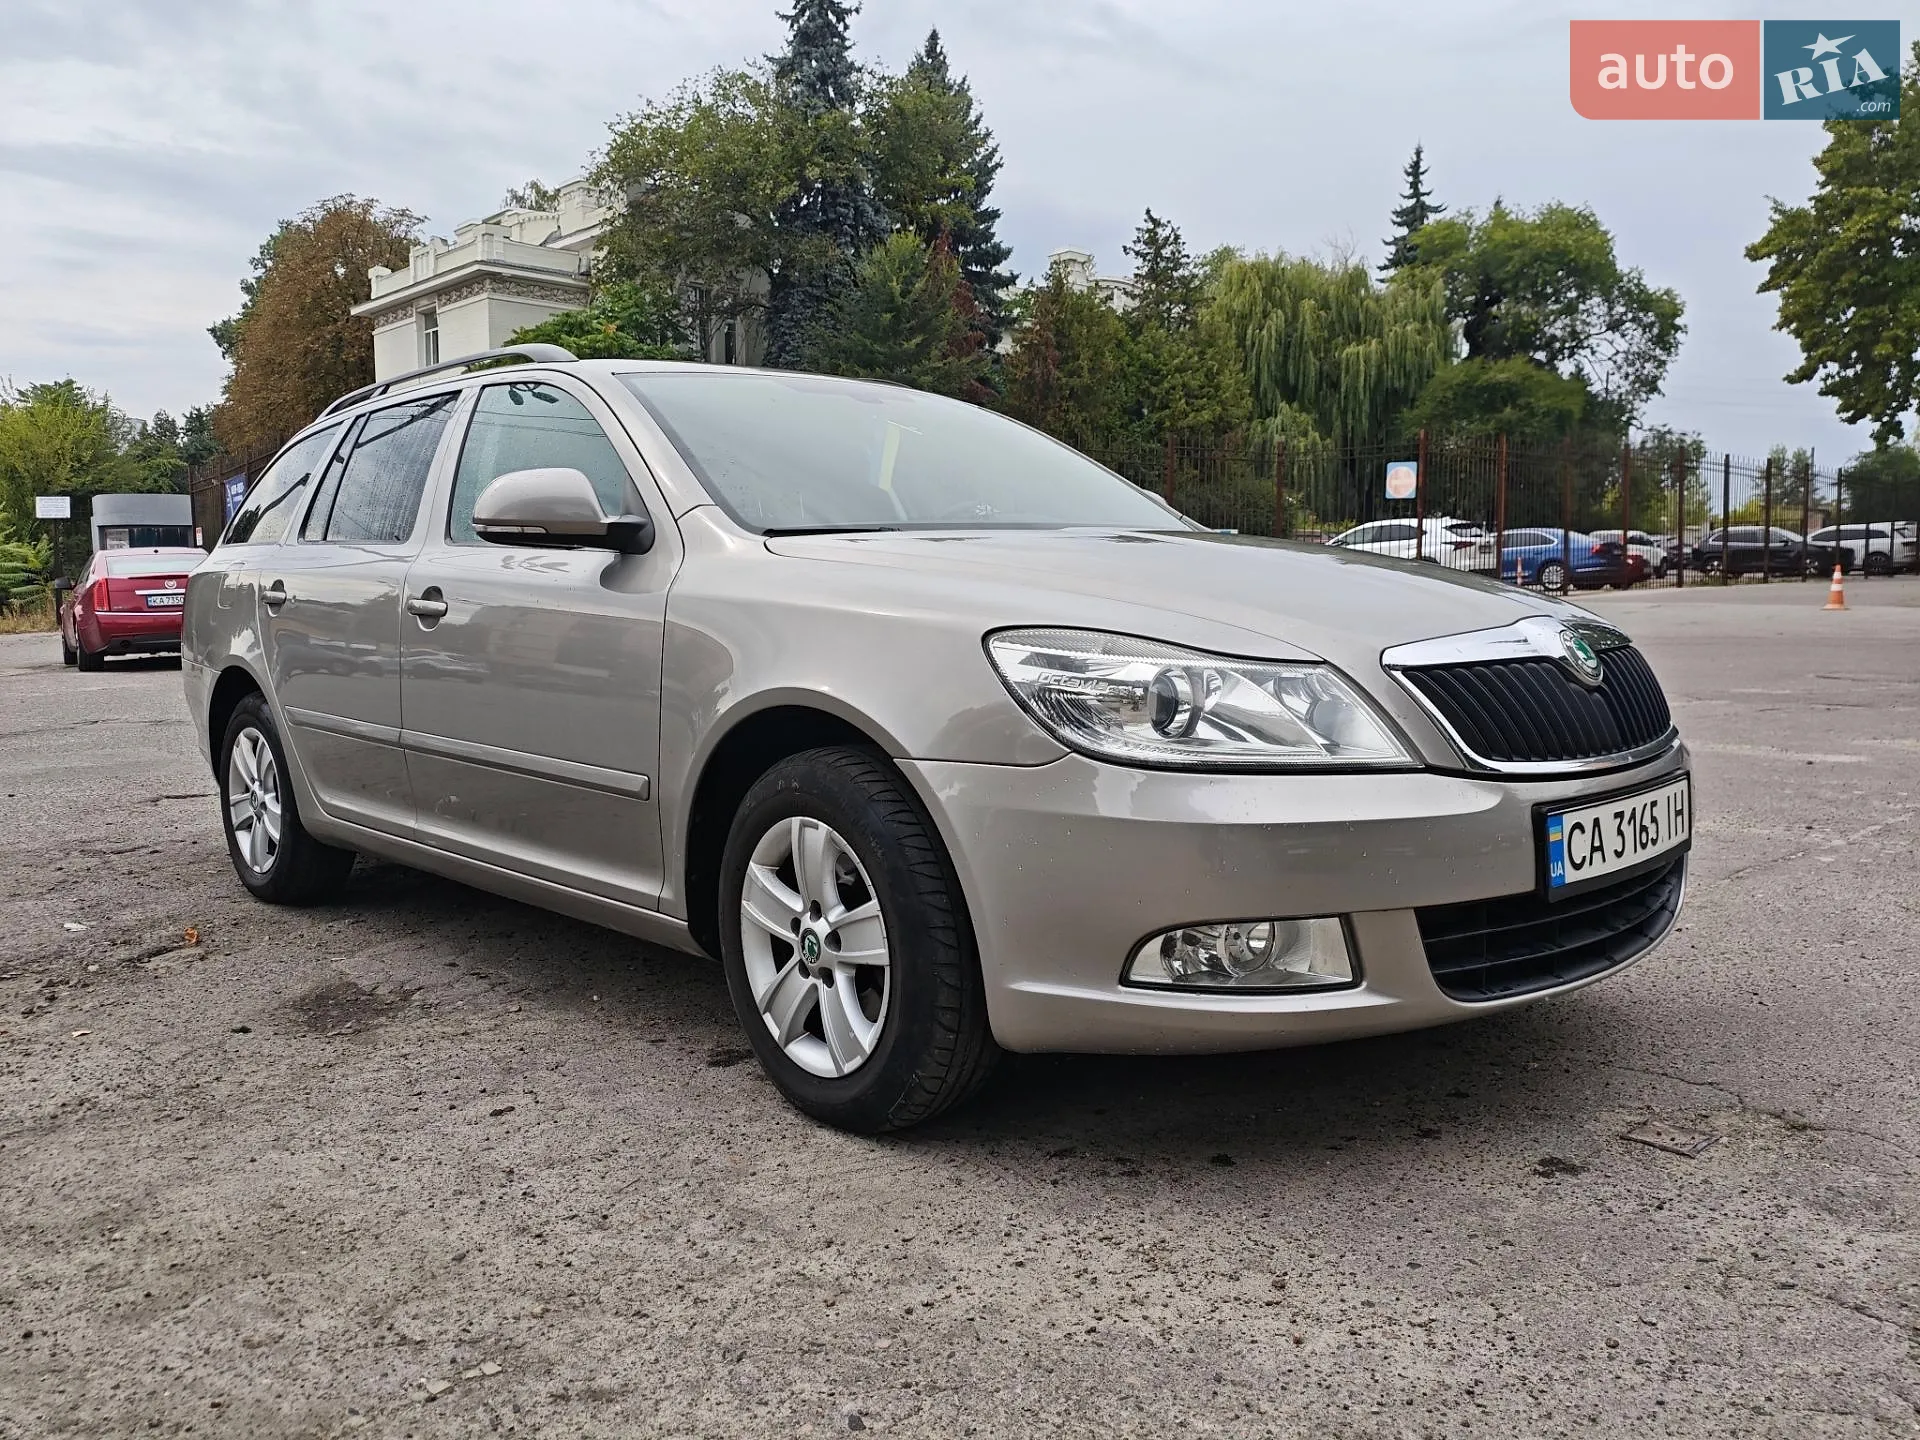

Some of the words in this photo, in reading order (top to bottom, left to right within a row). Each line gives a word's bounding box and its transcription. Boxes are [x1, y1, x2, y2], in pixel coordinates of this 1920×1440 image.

[1566, 816, 1607, 871] CA
[1613, 800, 1660, 859] 3165
[1667, 789, 1685, 841] IH
[1550, 861, 1565, 878] UA
